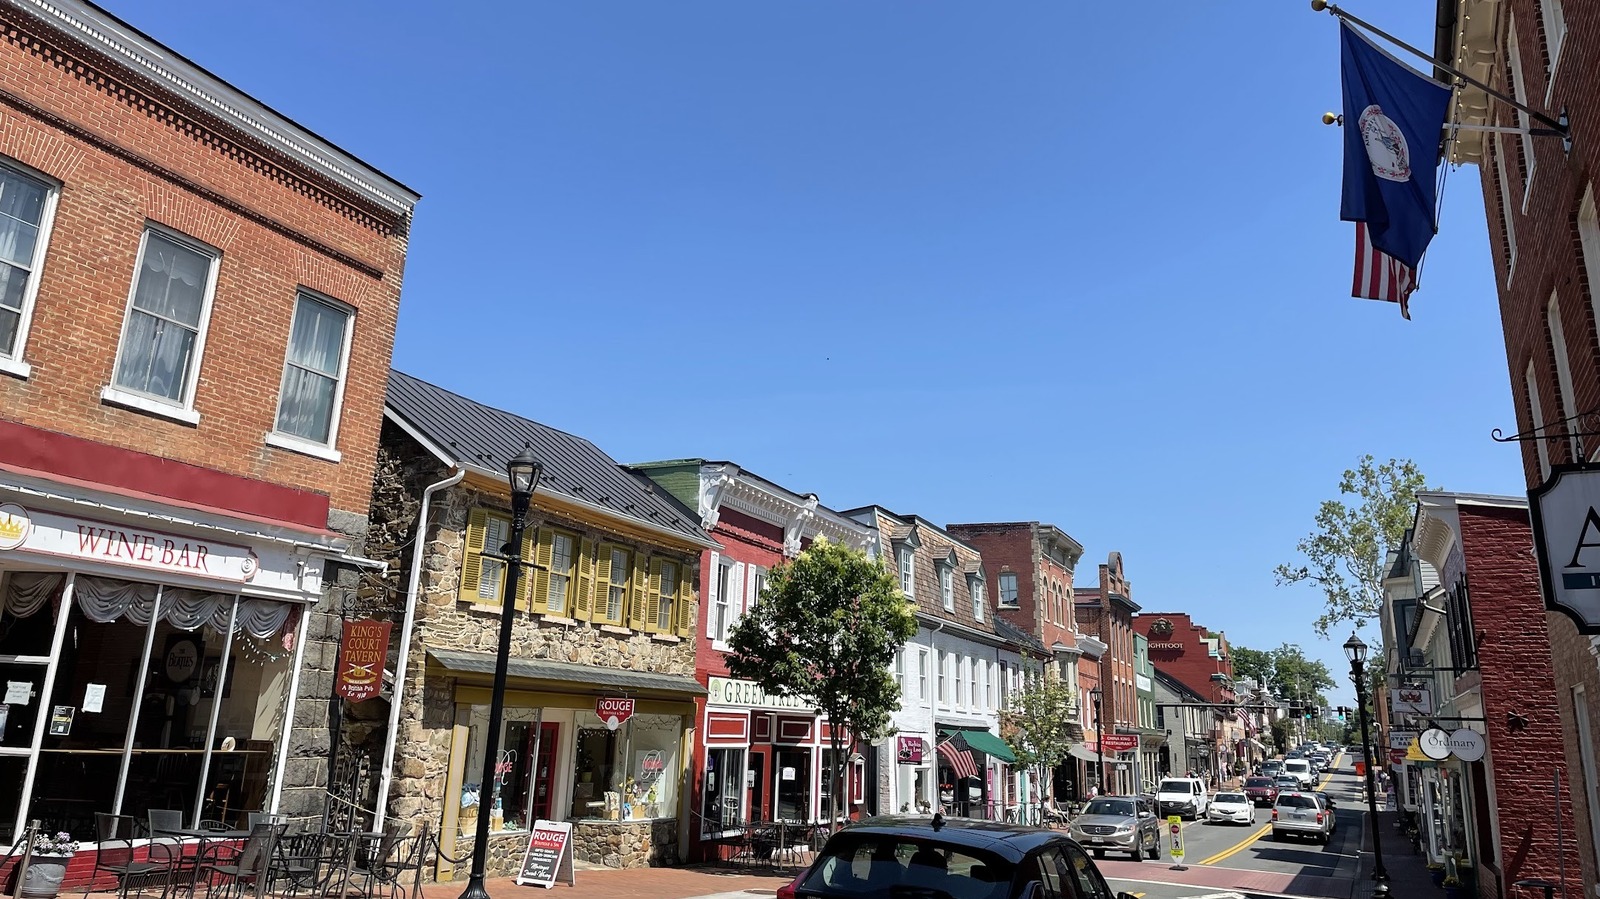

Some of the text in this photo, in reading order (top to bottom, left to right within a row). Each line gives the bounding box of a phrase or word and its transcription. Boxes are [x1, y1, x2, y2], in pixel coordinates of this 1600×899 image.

[77, 524, 208, 573] WINE BAR
[350, 625, 382, 638] KING'S
[348, 638, 382, 650] COURT
[345, 650, 382, 663] TAVERN
[724, 681, 768, 705] GREEN
[598, 700, 631, 711] ROUGE
[1428, 736, 1476, 749] Ordinary
[534, 832, 564, 843] ROUGE
